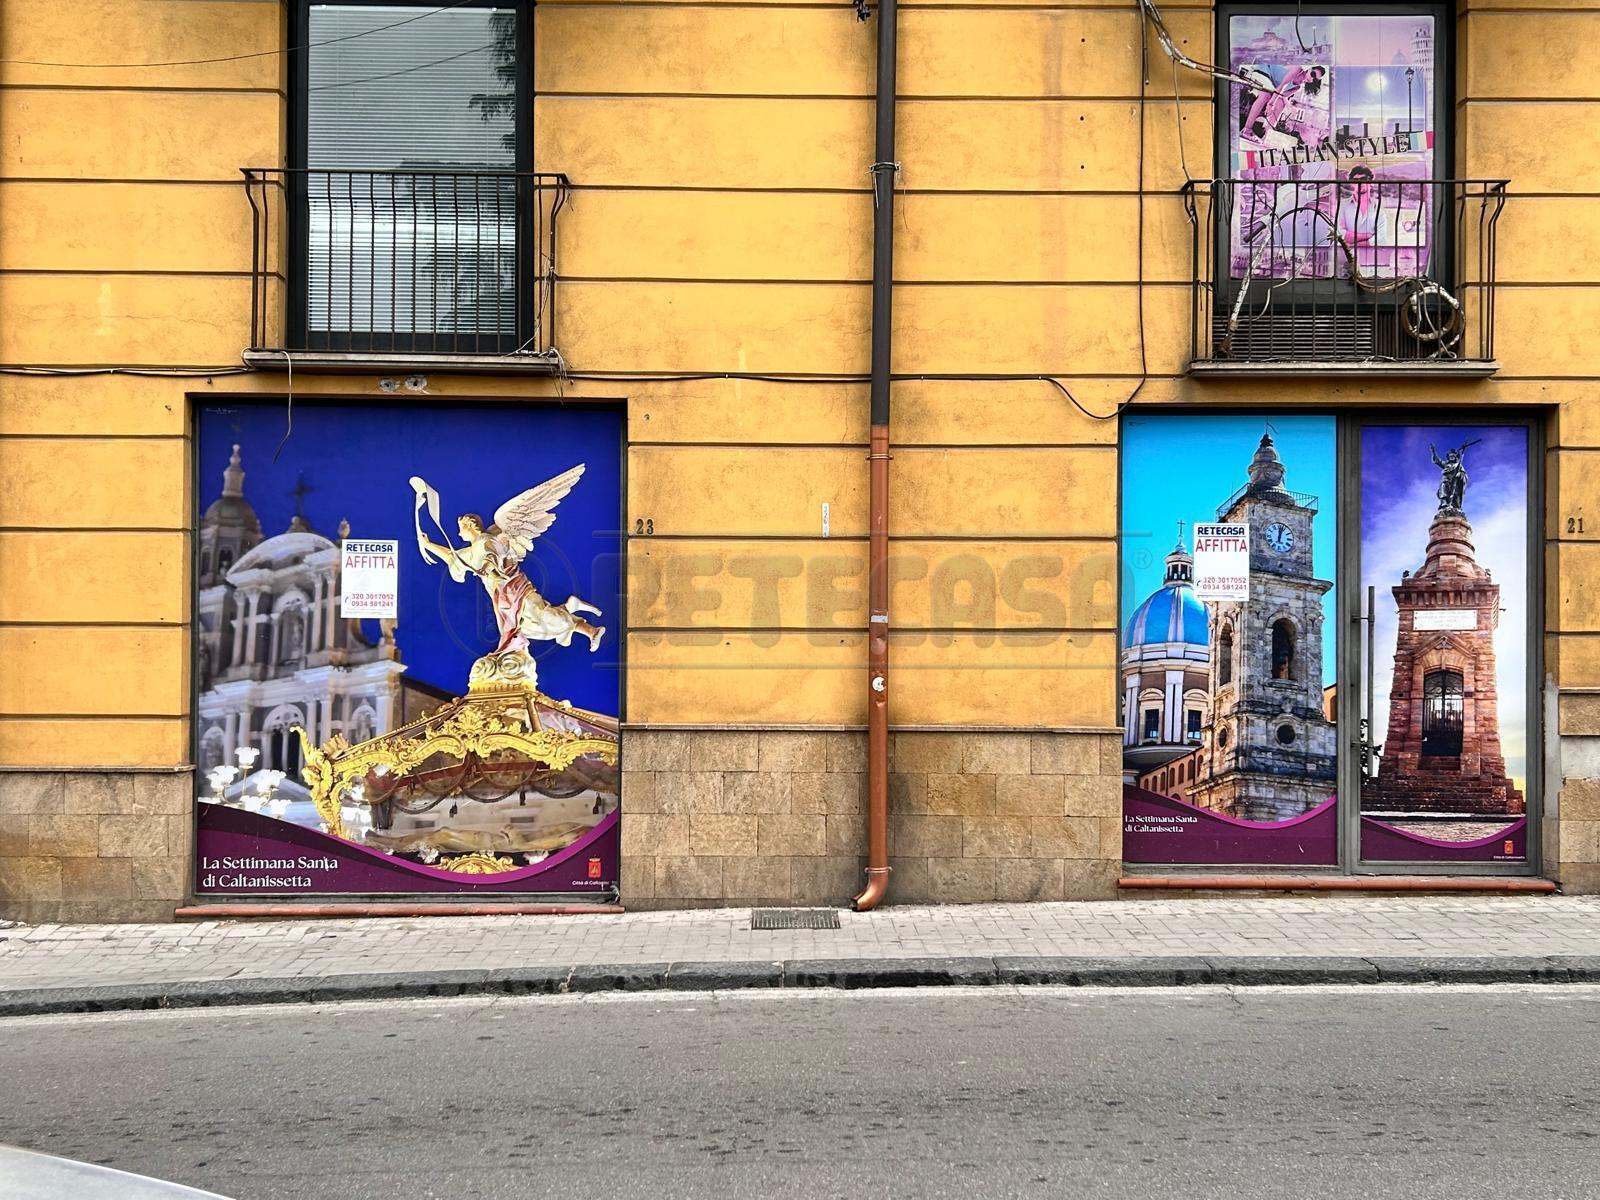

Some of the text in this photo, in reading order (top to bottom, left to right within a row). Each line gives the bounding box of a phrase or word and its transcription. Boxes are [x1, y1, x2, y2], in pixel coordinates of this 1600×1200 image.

[1259, 134, 1408, 167] ITALIAN STYLE
[636, 518, 653, 534] 23
[1197, 527, 1245, 535] RETECASA
[1568, 517, 1584, 533] 21
[346, 544, 393, 552] RETECASA
[1195, 539, 1248, 552] AFFITTA
[345, 556, 395, 568] AFFITTA
[1135, 815, 1175, 823] Settimana
[1175, 815, 1198, 823] Santa
[1125, 825, 1184, 833] di Caltanissetta
[202, 856, 338, 871] La Settimana Santa
[202, 874, 312, 888] di Caltanissetta
